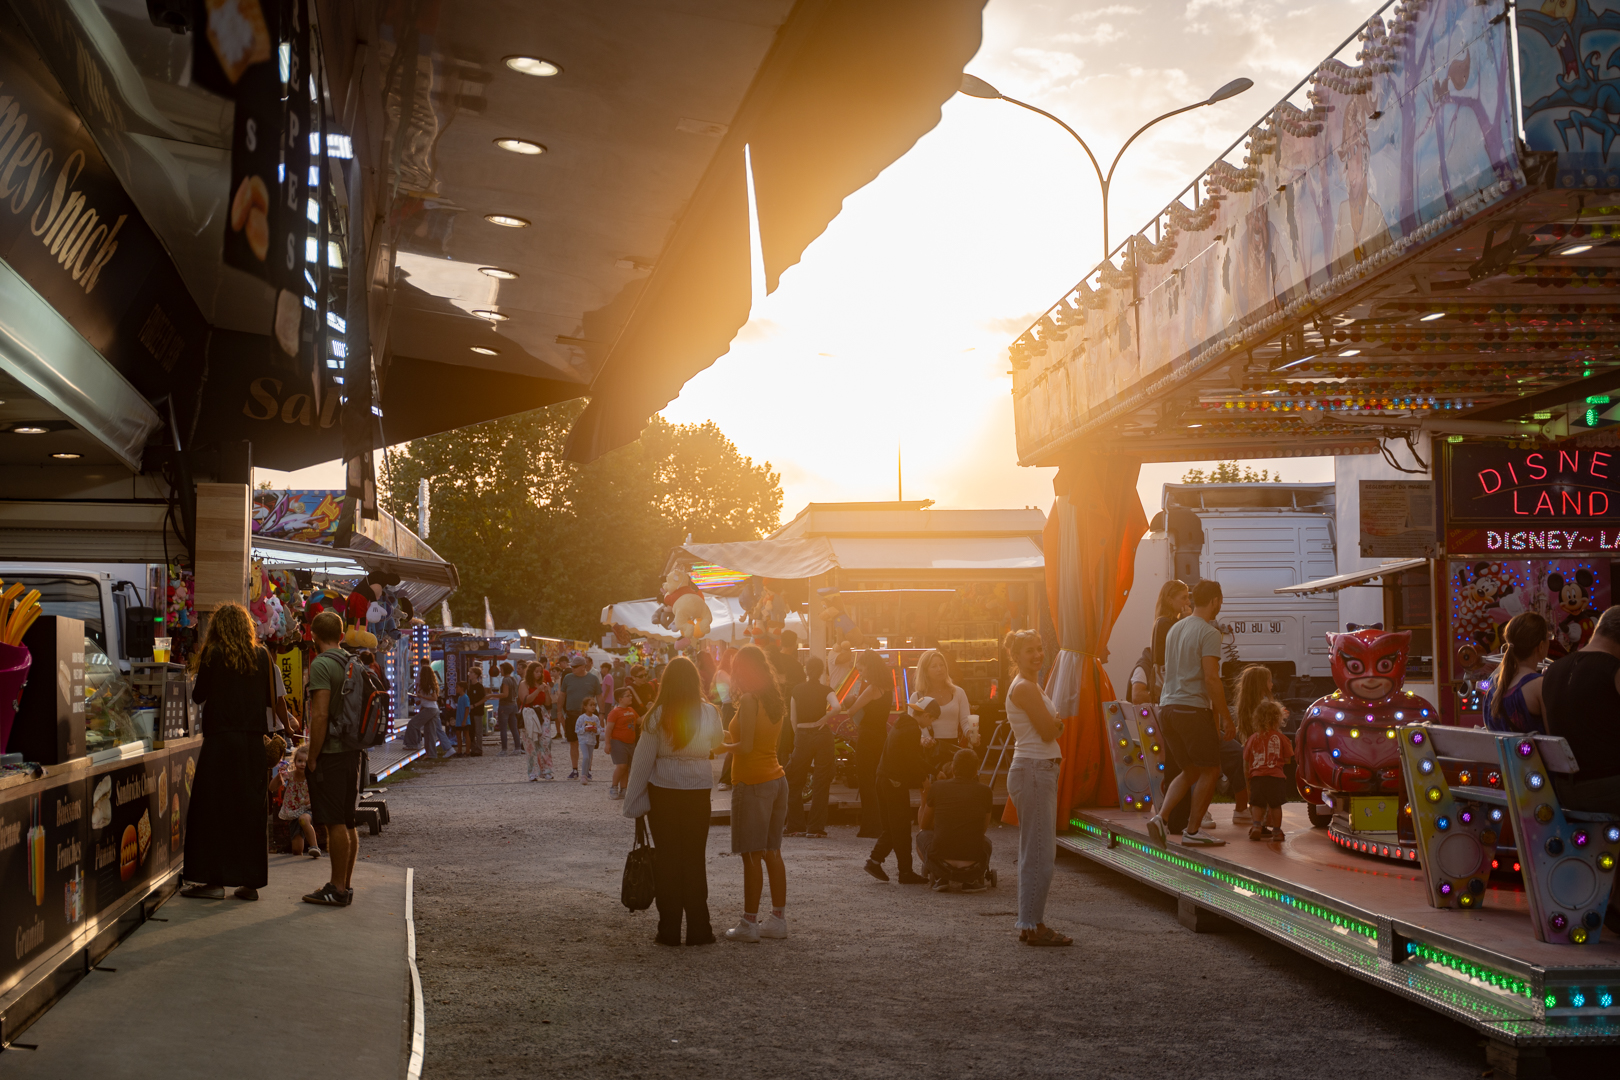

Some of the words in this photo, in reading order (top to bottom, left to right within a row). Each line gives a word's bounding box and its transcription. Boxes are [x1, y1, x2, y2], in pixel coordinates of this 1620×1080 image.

[31, 149, 129, 295] Snack
[1478, 450, 1612, 494] DISNE
[1514, 490, 1609, 516] LAND
[1234, 621, 1246, 634] 60
[281, 657, 292, 694] BOXER
